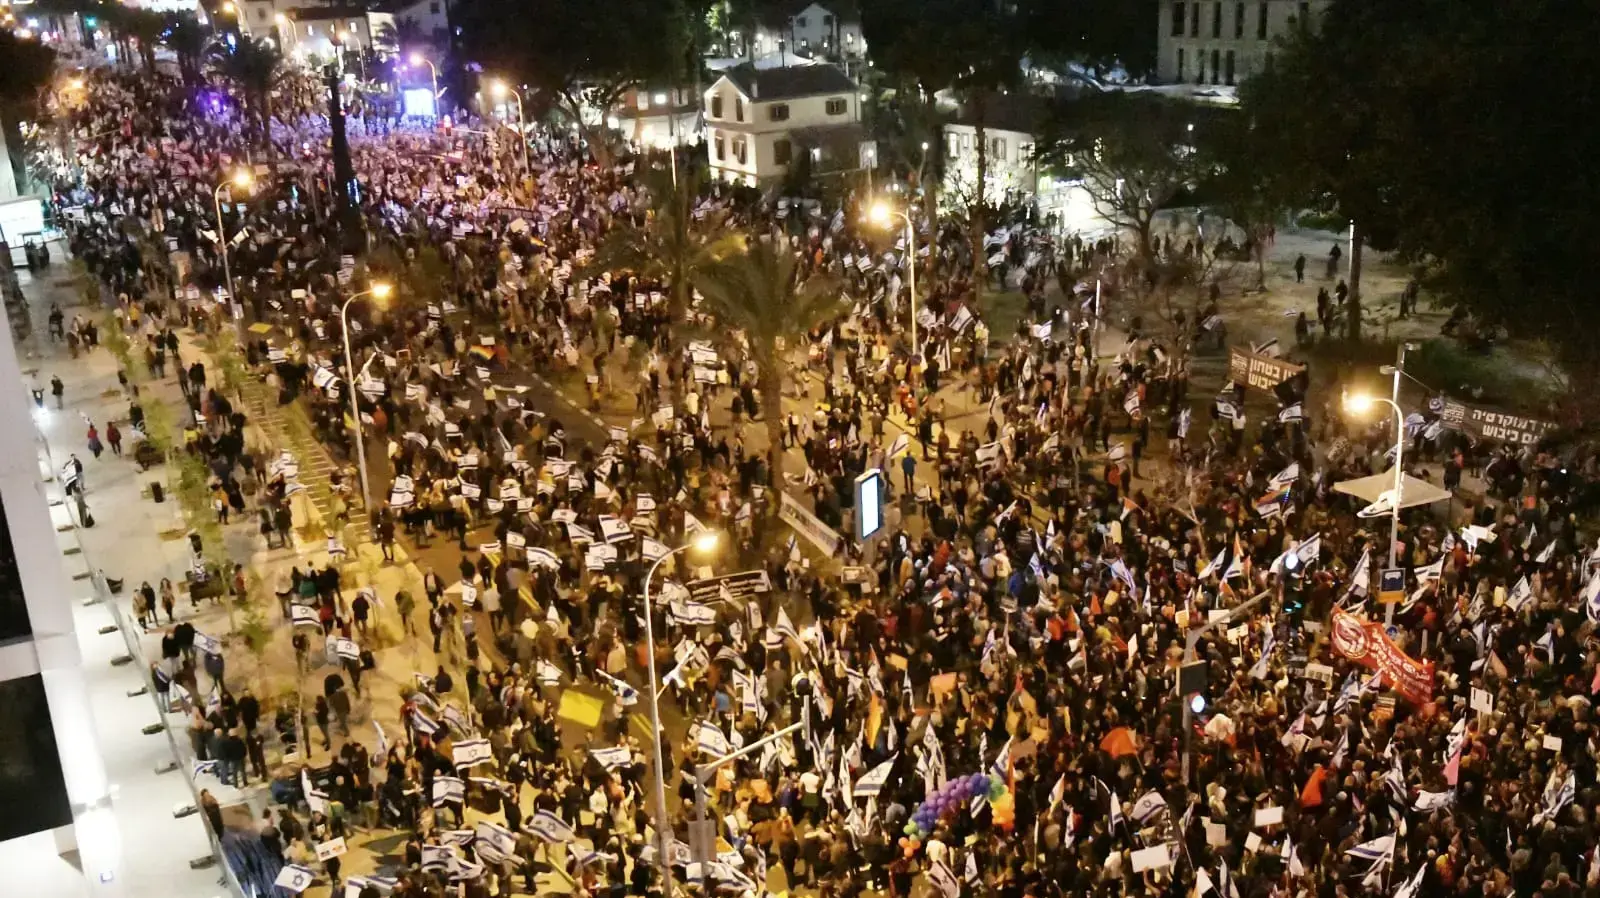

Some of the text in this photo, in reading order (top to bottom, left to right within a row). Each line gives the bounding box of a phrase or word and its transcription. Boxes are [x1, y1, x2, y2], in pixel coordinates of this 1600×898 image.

[1250, 358, 1280, 379] בטחון
[1472, 409, 1537, 430] דמוקרטיה
[1482, 424, 1520, 441] כיבוש
